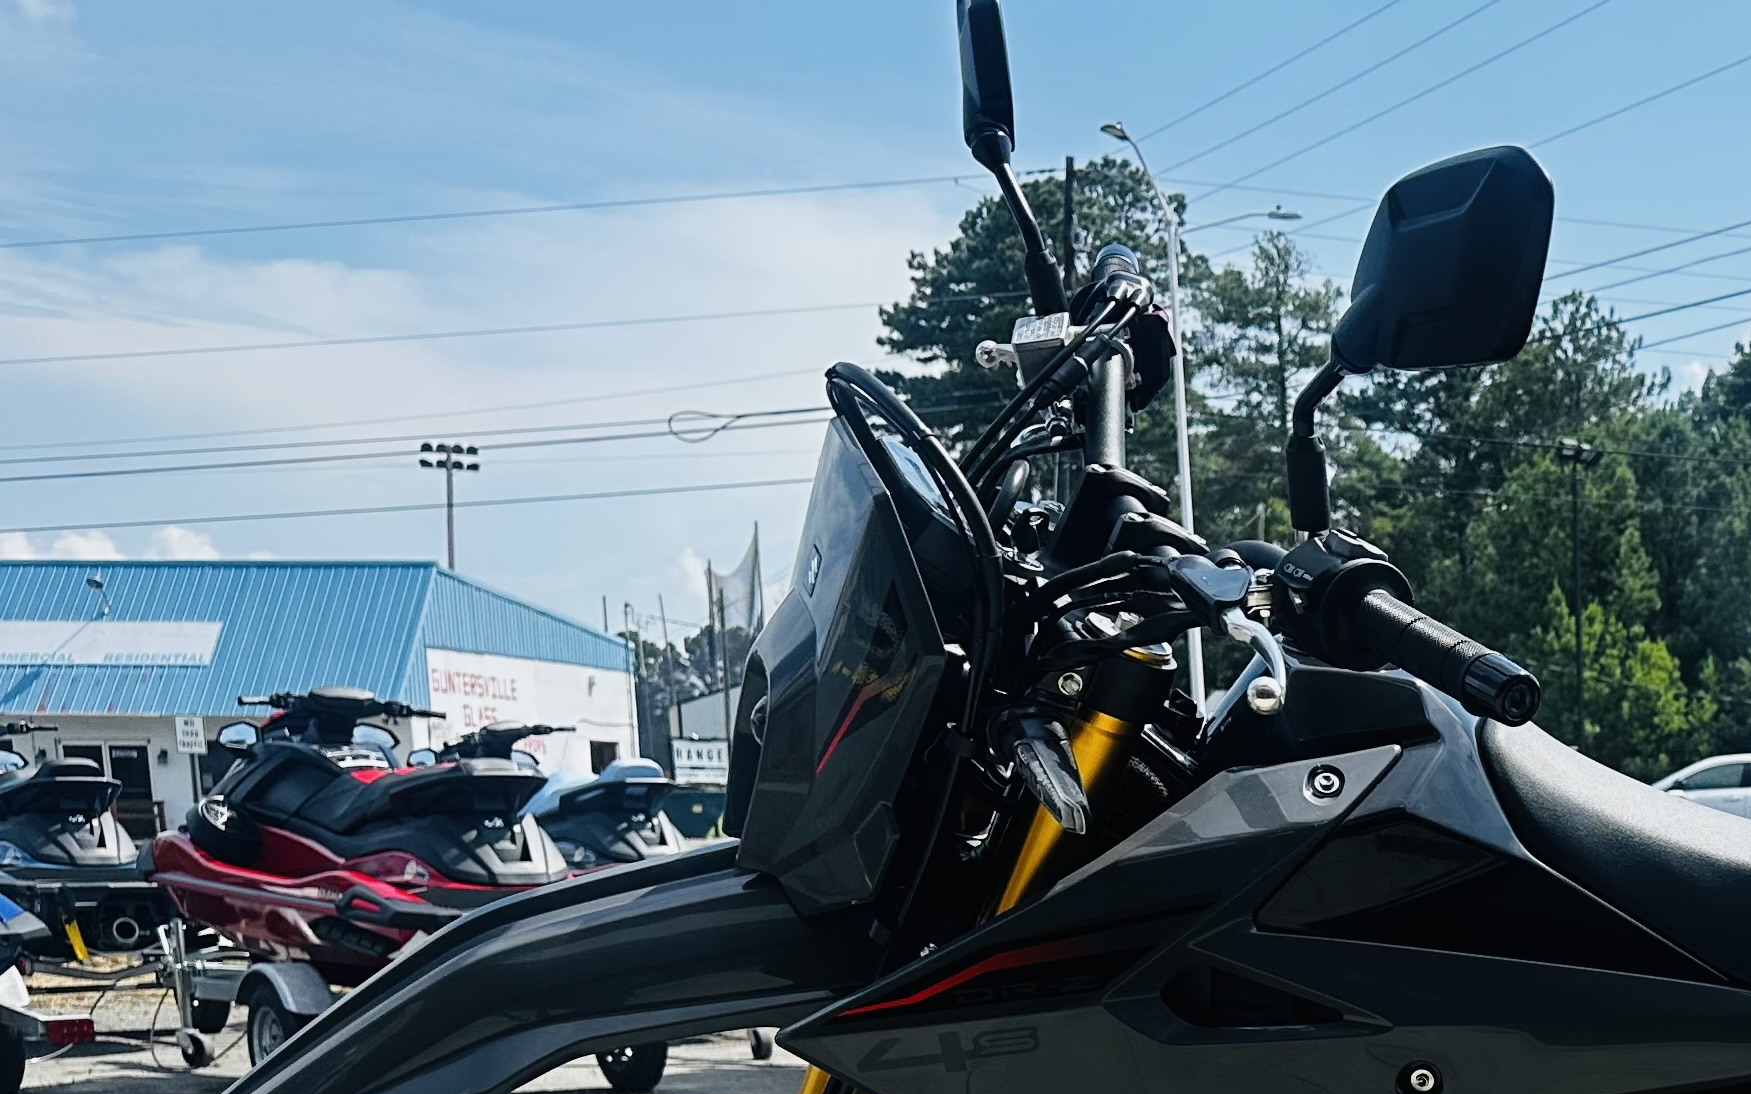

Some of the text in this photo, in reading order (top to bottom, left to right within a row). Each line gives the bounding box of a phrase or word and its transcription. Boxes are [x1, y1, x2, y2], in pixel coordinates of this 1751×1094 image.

[103, 652, 206, 664] RESIDENTIAL
[431, 668, 518, 701] GUNTERSVILLE
[676, 747, 724, 763] RANGE
